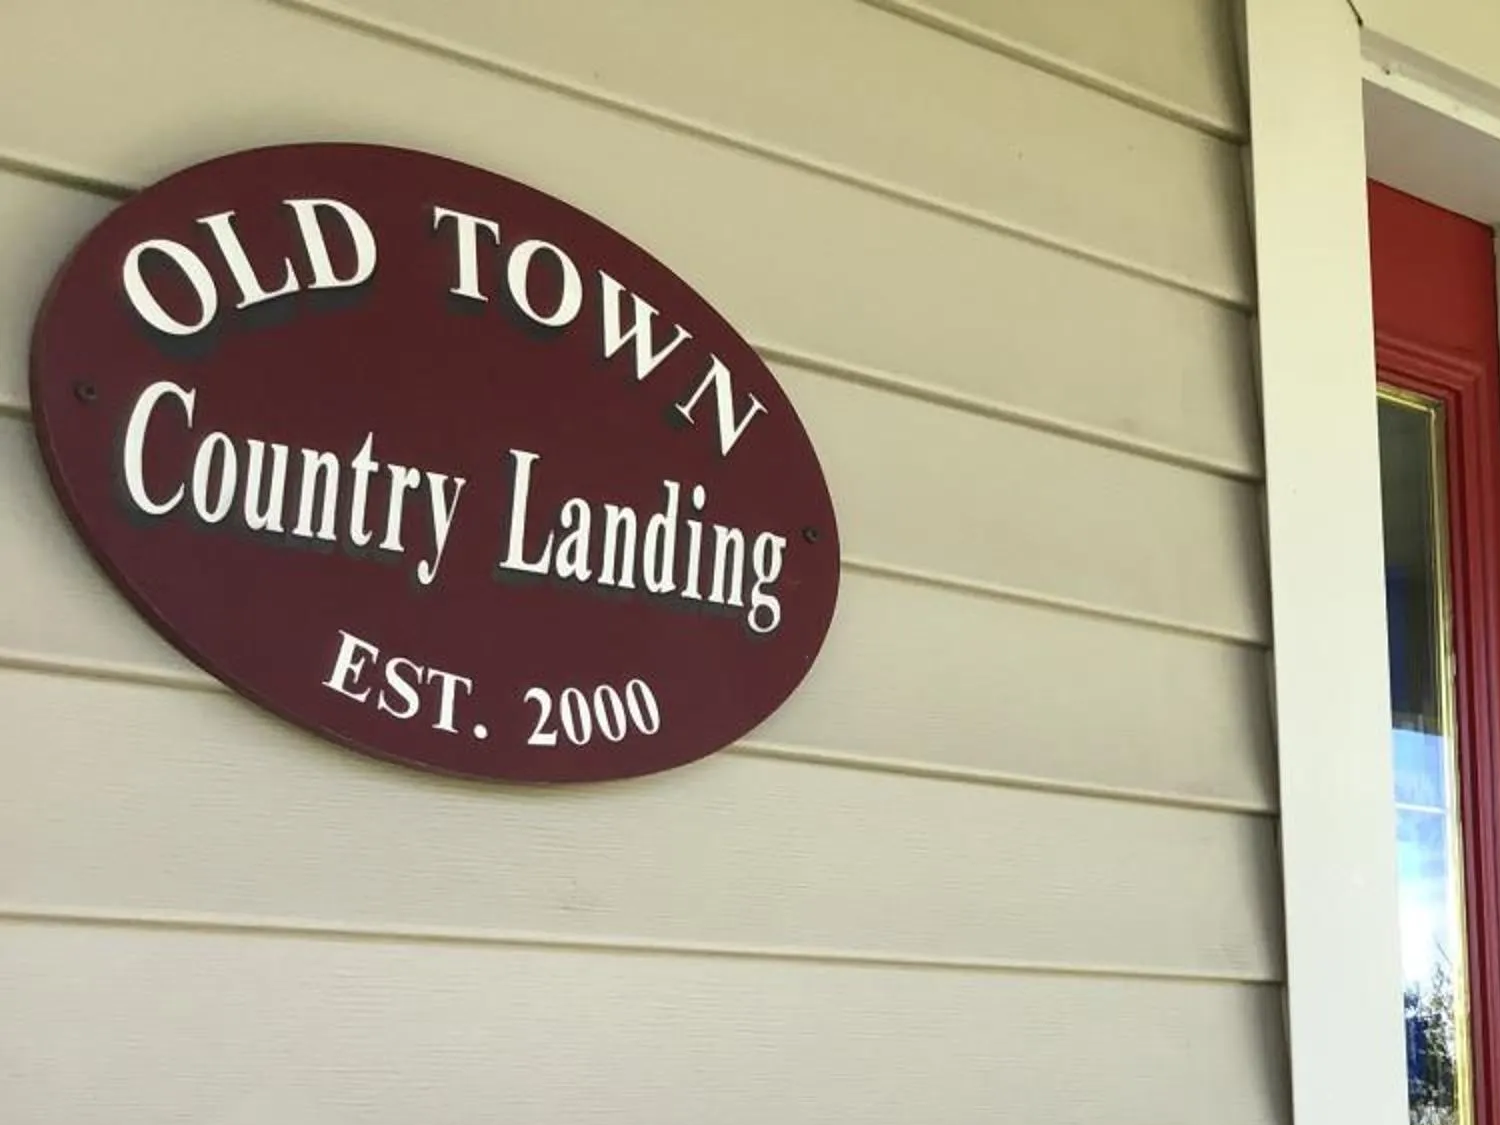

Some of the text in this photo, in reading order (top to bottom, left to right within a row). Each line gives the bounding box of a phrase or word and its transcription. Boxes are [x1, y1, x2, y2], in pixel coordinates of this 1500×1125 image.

[122, 198, 768, 457] OLD TOWN
[123, 380, 787, 633] Country Landing
[321, 629, 661, 746] EST. 2000
